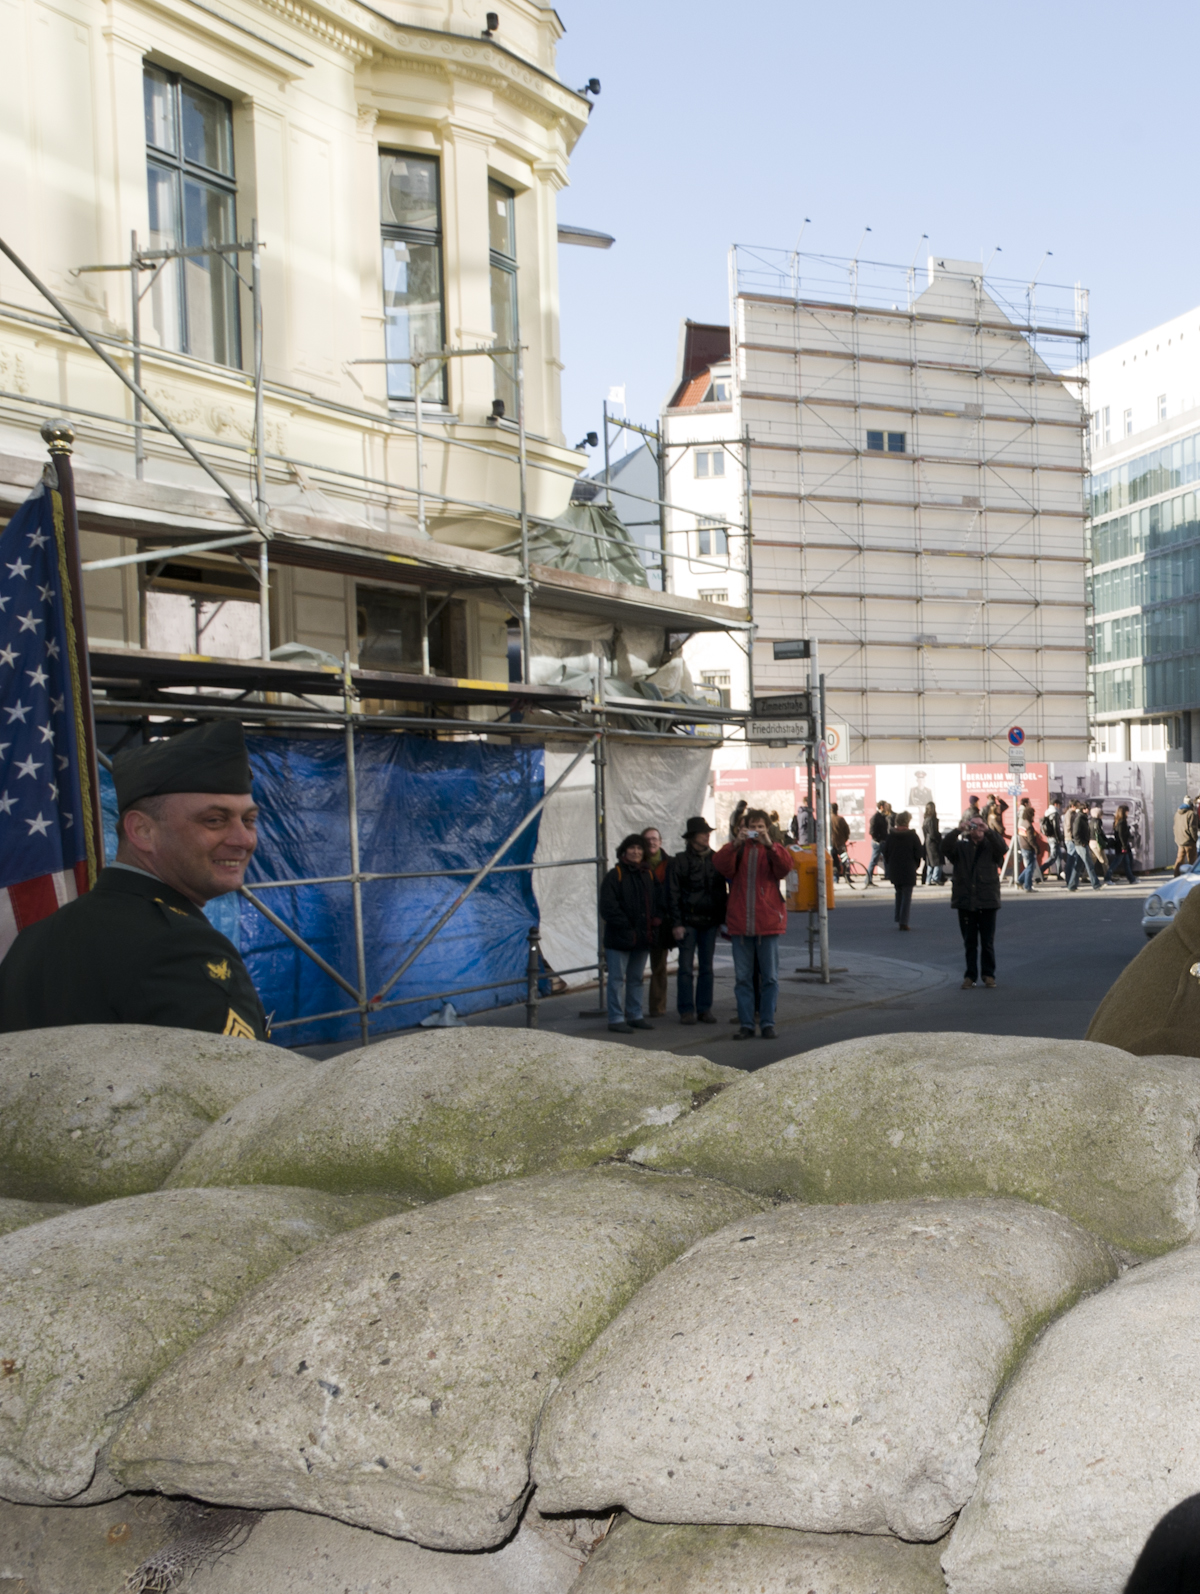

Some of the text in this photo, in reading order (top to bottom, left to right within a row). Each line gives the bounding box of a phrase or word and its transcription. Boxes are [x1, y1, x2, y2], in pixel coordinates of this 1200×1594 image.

[761, 699, 803, 712] Zimmerstraße
[752, 723, 804, 735] Friedrichstraße
[828, 733, 835, 746] 0
